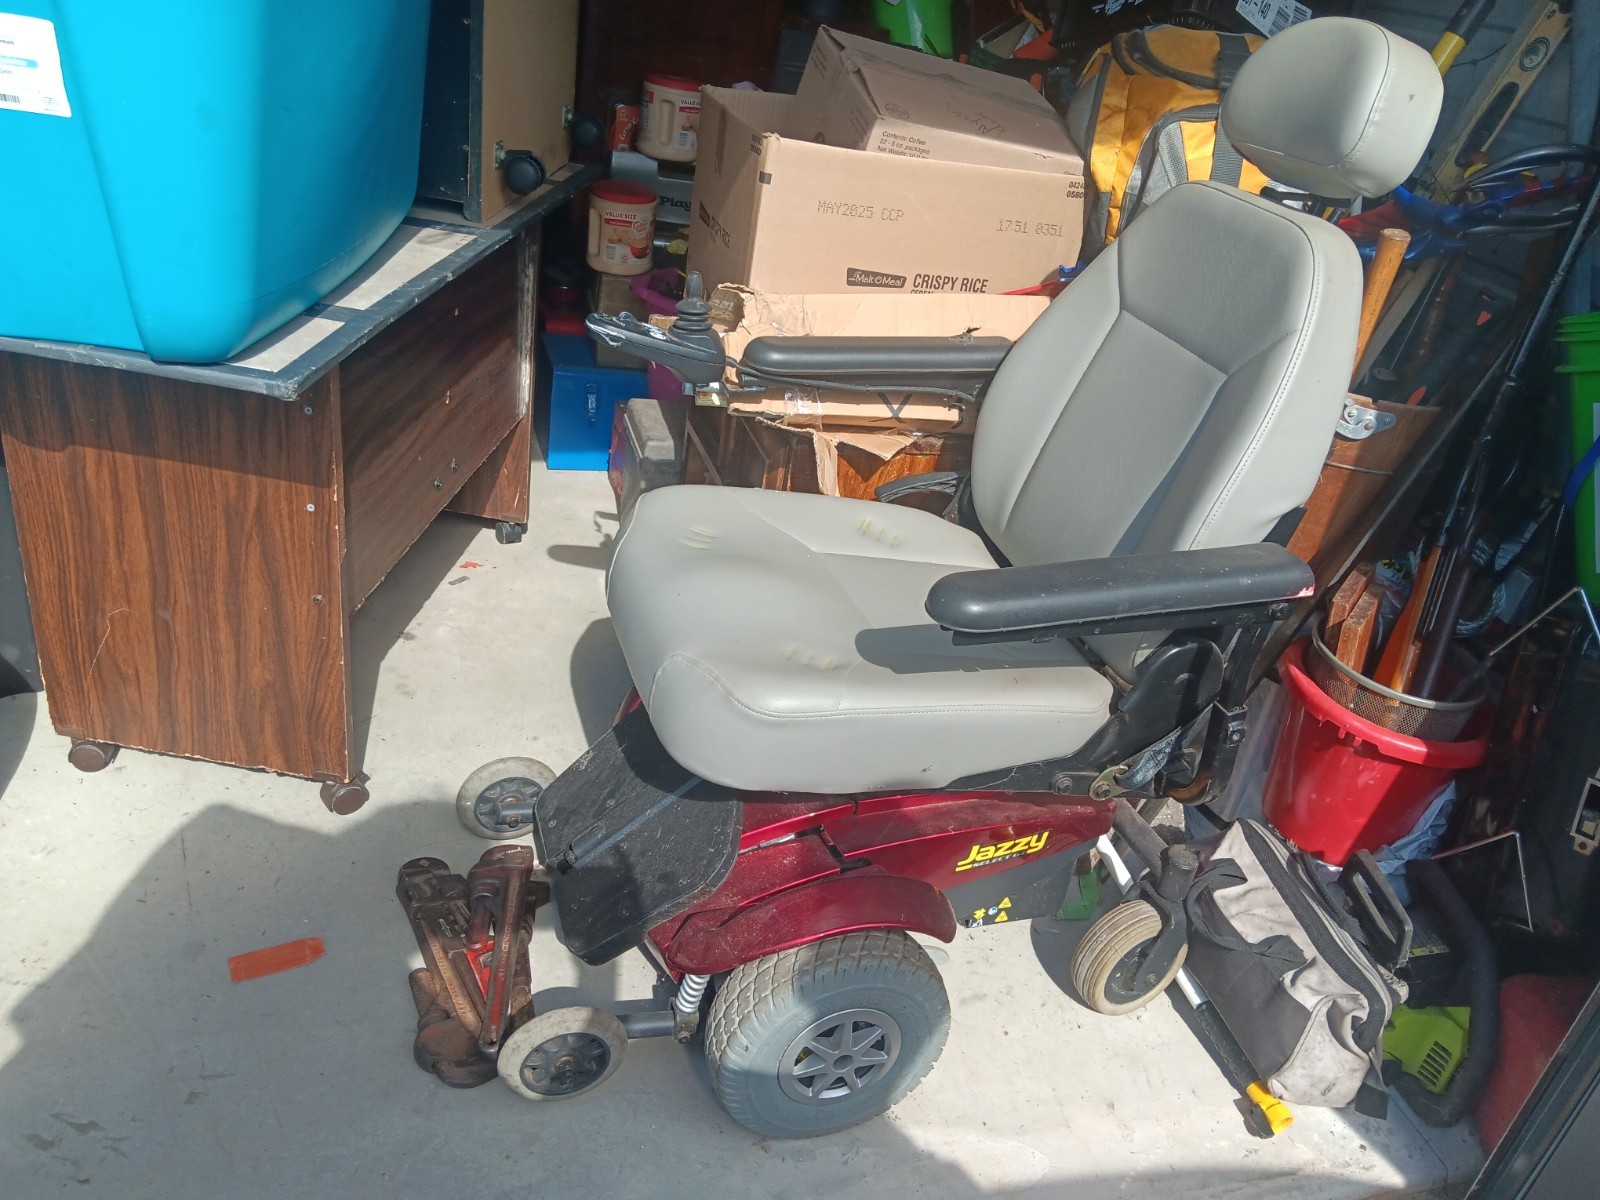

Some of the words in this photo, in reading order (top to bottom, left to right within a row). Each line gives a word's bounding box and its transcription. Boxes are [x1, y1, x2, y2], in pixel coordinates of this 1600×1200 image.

[605, 210, 623, 218] VALUE
[817, 200, 874, 219] MAY2025
[881, 207, 904, 222] CCP
[996, 219, 1027, 233] 1751
[1035, 222, 1062, 237] 0351
[913, 273, 959, 291] CRISPY
[960, 277, 989, 294] RICE
[955, 831, 1049, 872] Jazzy
